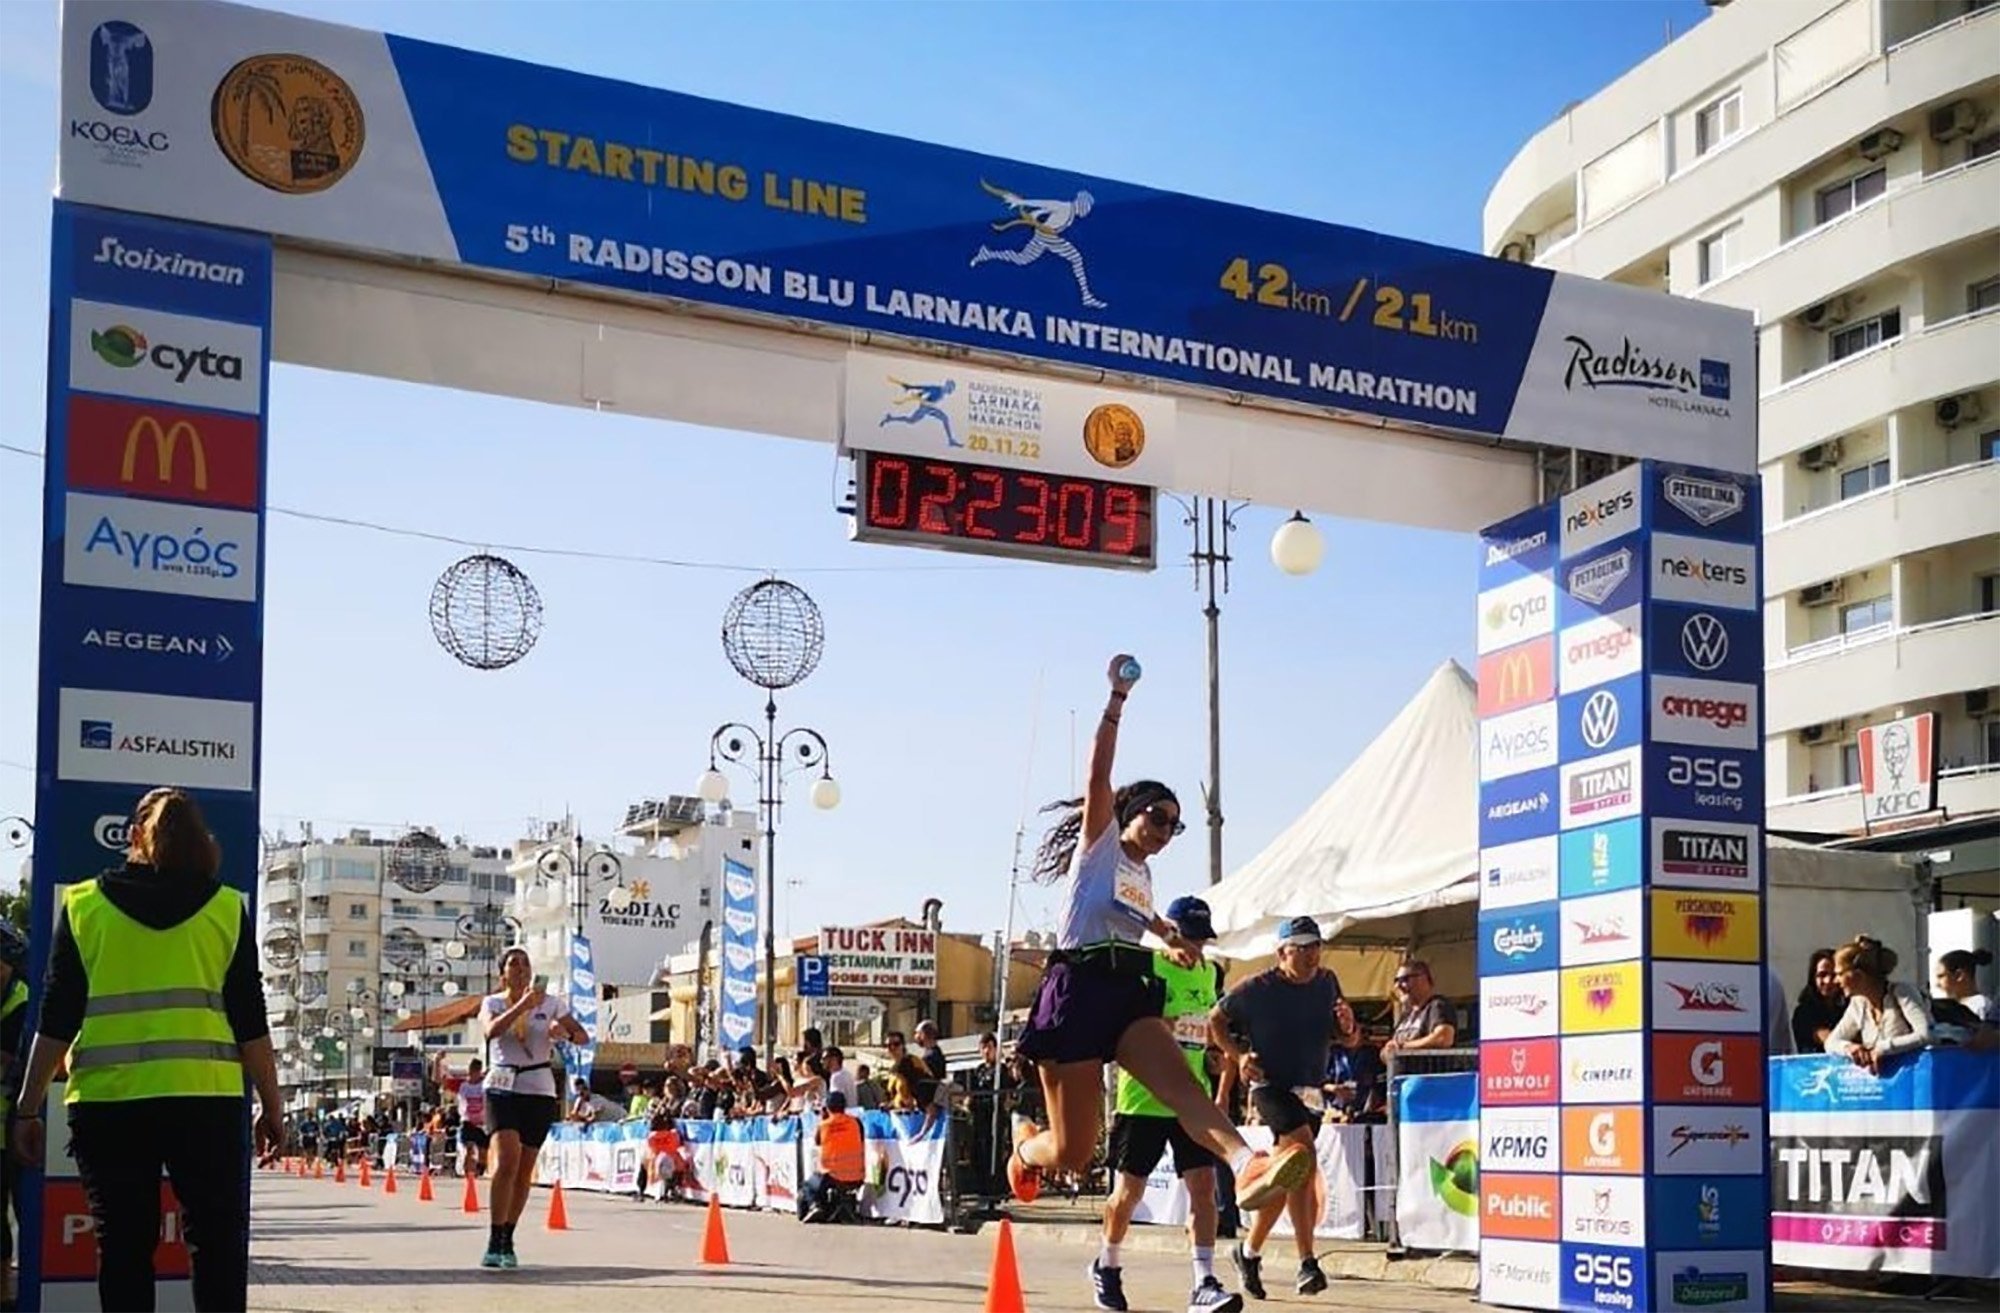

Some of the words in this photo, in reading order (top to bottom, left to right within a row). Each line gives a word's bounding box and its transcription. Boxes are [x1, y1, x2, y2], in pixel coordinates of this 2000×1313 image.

[506, 124, 749, 201] STARTING
[764, 172, 867, 224] LINE
[94, 236, 244, 286] Stoiximan
[505, 223, 556, 254] 5th
[569, 233, 772, 295] RADISSON
[784, 270, 854, 307] BLU
[866, 284, 1036, 340] LARNAKA
[1046, 316, 1301, 385] INTERNATIONAL
[1309, 362, 1477, 415] MARATHON
[151, 344, 242, 383] cyta
[1564, 335, 1697, 392] Radisson
[1702, 372, 1727, 387] BLU
[968, 393, 1041, 412] LARNAKA
[968, 413, 1042, 431] MARATHON
[967, 434, 1041, 460] 20.11.22
[1671, 481, 1735, 504] PETROLINA
[870, 460, 1137, 554] 02:23:09
[1567, 490, 1634, 535] nexters
[84, 516, 239, 578] Αγρός
[1661, 555, 1747, 586] nexters
[1509, 595, 1548, 627] cyta
[82, 628, 207, 655] AEGEAN
[1662, 695, 1747, 729] omega
[119, 736, 236, 760] ASFALISTIKI
[1580, 765, 1630, 799] TITAN
[1695, 791, 1743, 812] leasing
[1875, 790, 1921, 816] KFC
[1679, 837, 1744, 862] TITAN
[602, 915, 644, 928] TOURIST
[823, 927, 886, 952] TUCK
[895, 931, 935, 953] INN
[804, 958, 822, 982] P
[828, 954, 902, 970] ESTAURANT
[910, 958, 935, 971] BAR
[831, 973, 868, 984] OOMS
[873, 974, 899, 985] FOR
[902, 974, 934, 986] RENT
[1688, 981, 1740, 1005] ACS
[1690, 1041, 1724, 1086] G
[1589, 1111, 1615, 1156] G
[1488, 1136, 1548, 1159] KPMG
[1779, 1148, 1930, 1204] TITAN
[1487, 1194, 1552, 1219] Public
[1821, 1222, 1933, 1244] OFFICE
[1594, 1288, 1633, 1310] leasing
